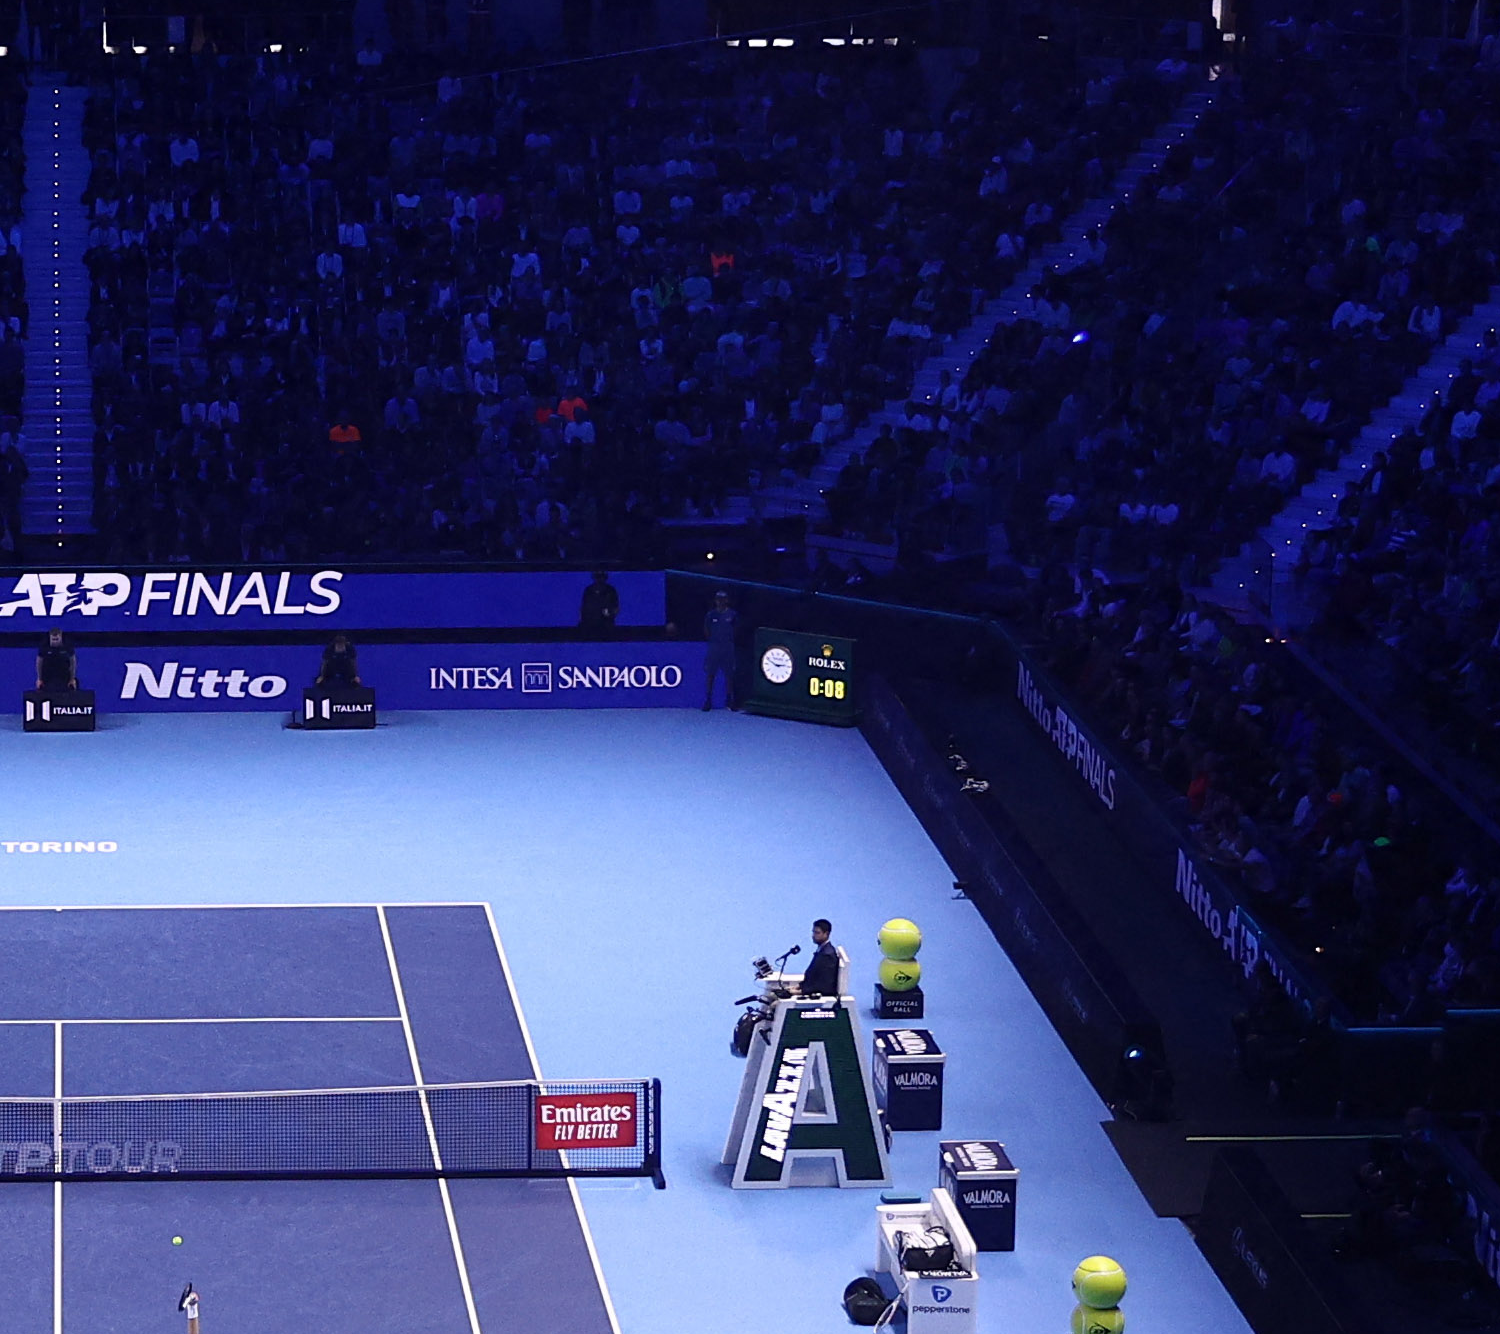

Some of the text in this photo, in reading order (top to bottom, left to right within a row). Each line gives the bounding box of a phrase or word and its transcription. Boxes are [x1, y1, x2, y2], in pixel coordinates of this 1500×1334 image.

[137, 570, 345, 617] FINALS
[808, 656, 846, 671] ROLEX
[119, 661, 288, 700] Nitto
[429, 664, 683, 691] INTESA SANPAOLO
[809, 677, 845, 699] 0:08
[53, 705, 93, 716] ITALIA.IT
[333, 703, 373, 714] ITALIA.IT
[1015, 660, 1053, 735] Nitto
[1072, 731, 1117, 811] FINALS
[1, 840, 119, 854] TORINO
[1175, 846, 1222, 940] Nitto
[894, 1071, 938, 1086] VALMORA
[538, 1101, 633, 1126] Emirates
[554, 1121, 620, 1140] FLY BETTER
[60, 1140, 183, 1175] TOUR
[962, 1189, 1011, 1204] VALMORA
[911, 1304, 971, 1315] pepperstone
